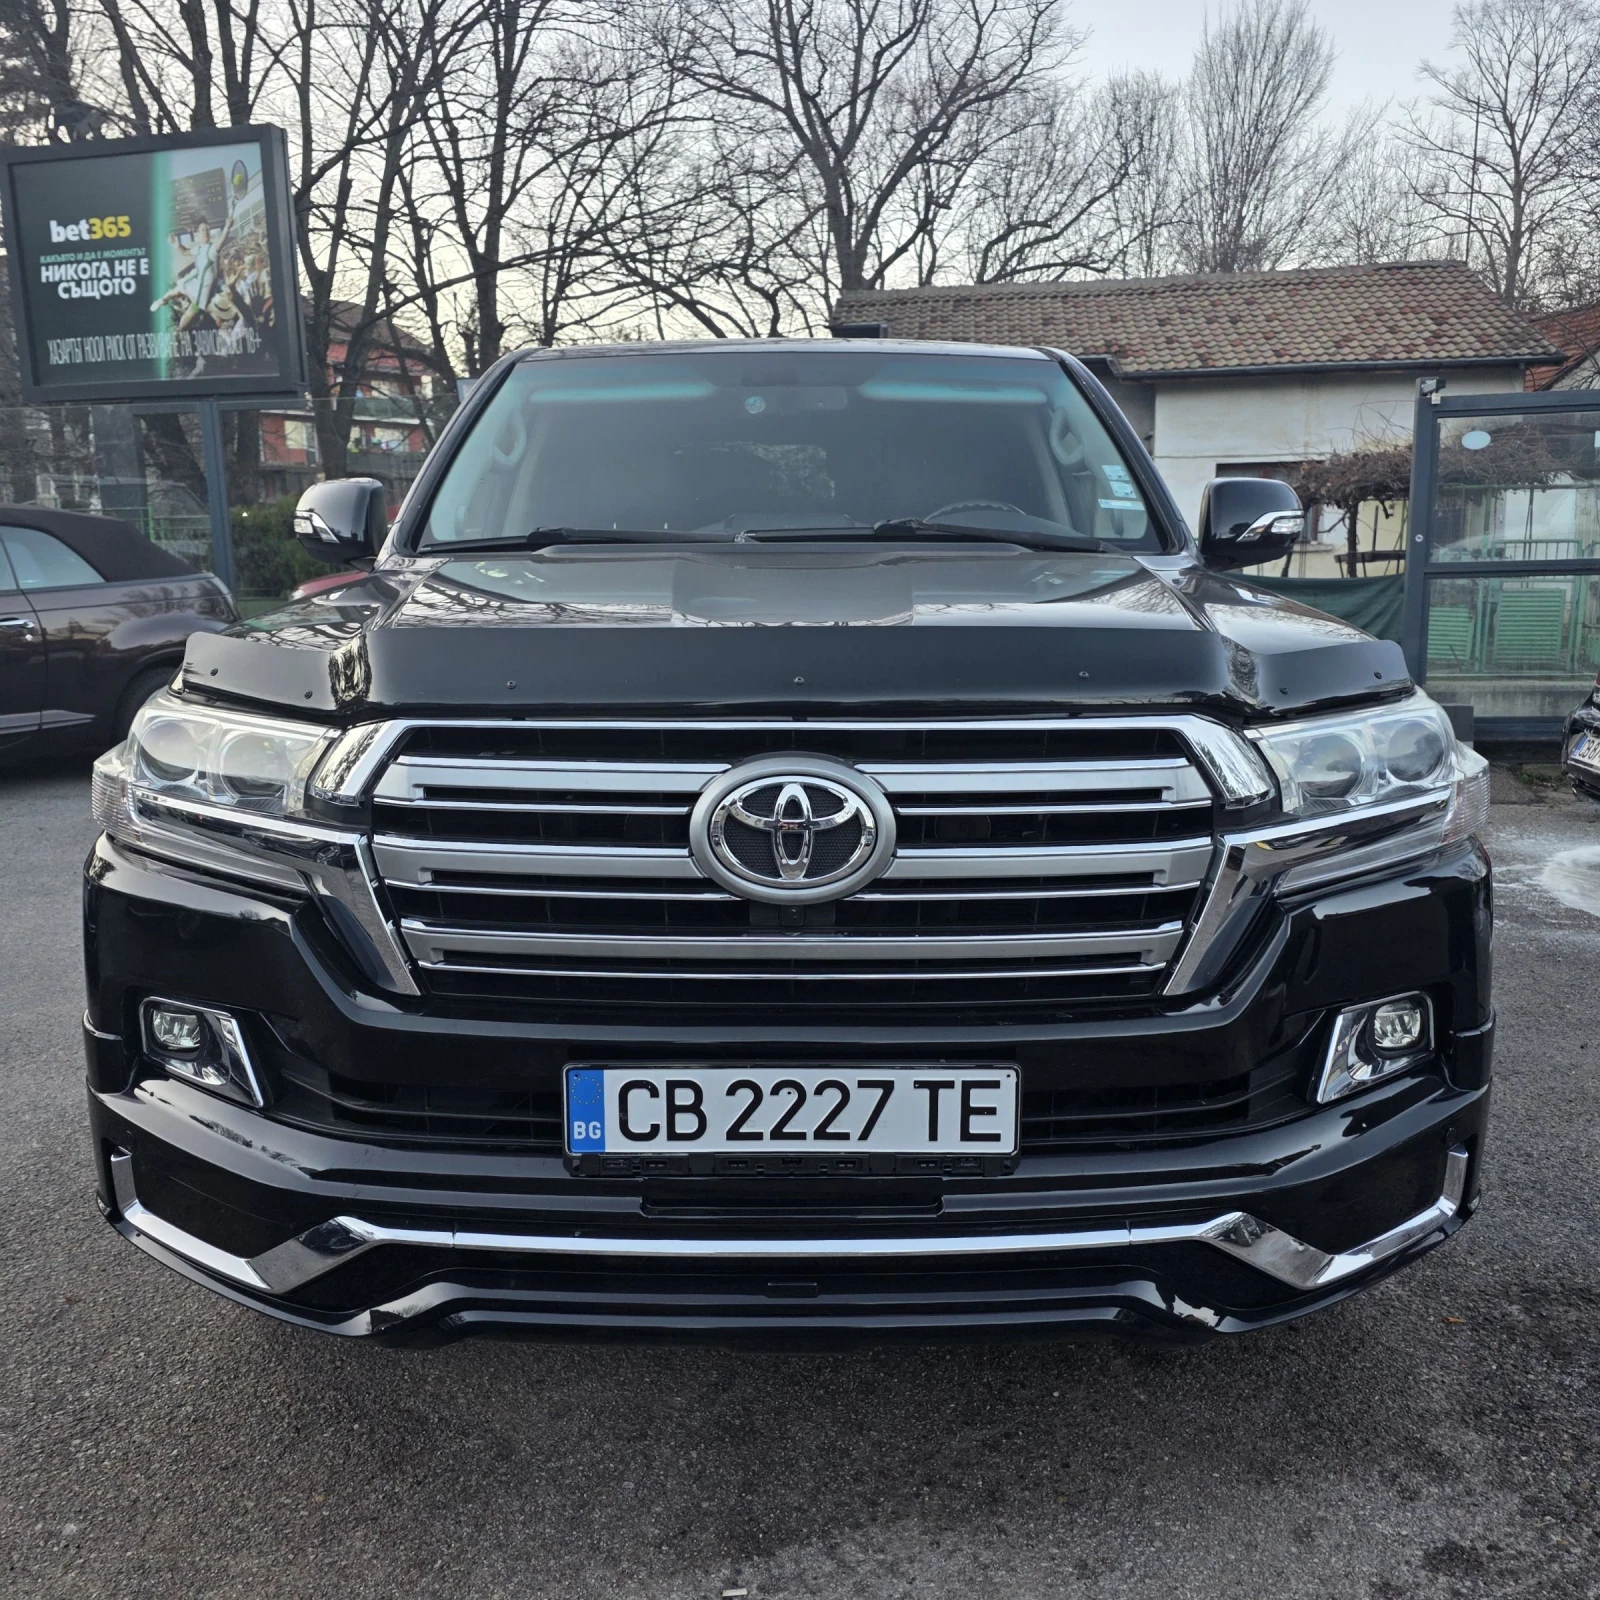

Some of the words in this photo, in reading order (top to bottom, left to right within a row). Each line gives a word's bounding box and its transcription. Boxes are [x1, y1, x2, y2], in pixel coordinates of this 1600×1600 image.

[49, 215, 131, 243] bet365
[41, 261, 111, 283] НИКОГА
[114, 258, 136, 277] НЕ
[139, 257, 149, 275] Е
[57, 277, 136, 300] СЪЩОТО
[618, 1079, 707, 1142] CB
[725, 1079, 895, 1141] 2227
[913, 1079, 1001, 1142] TE
[573, 1121, 601, 1140] BG
